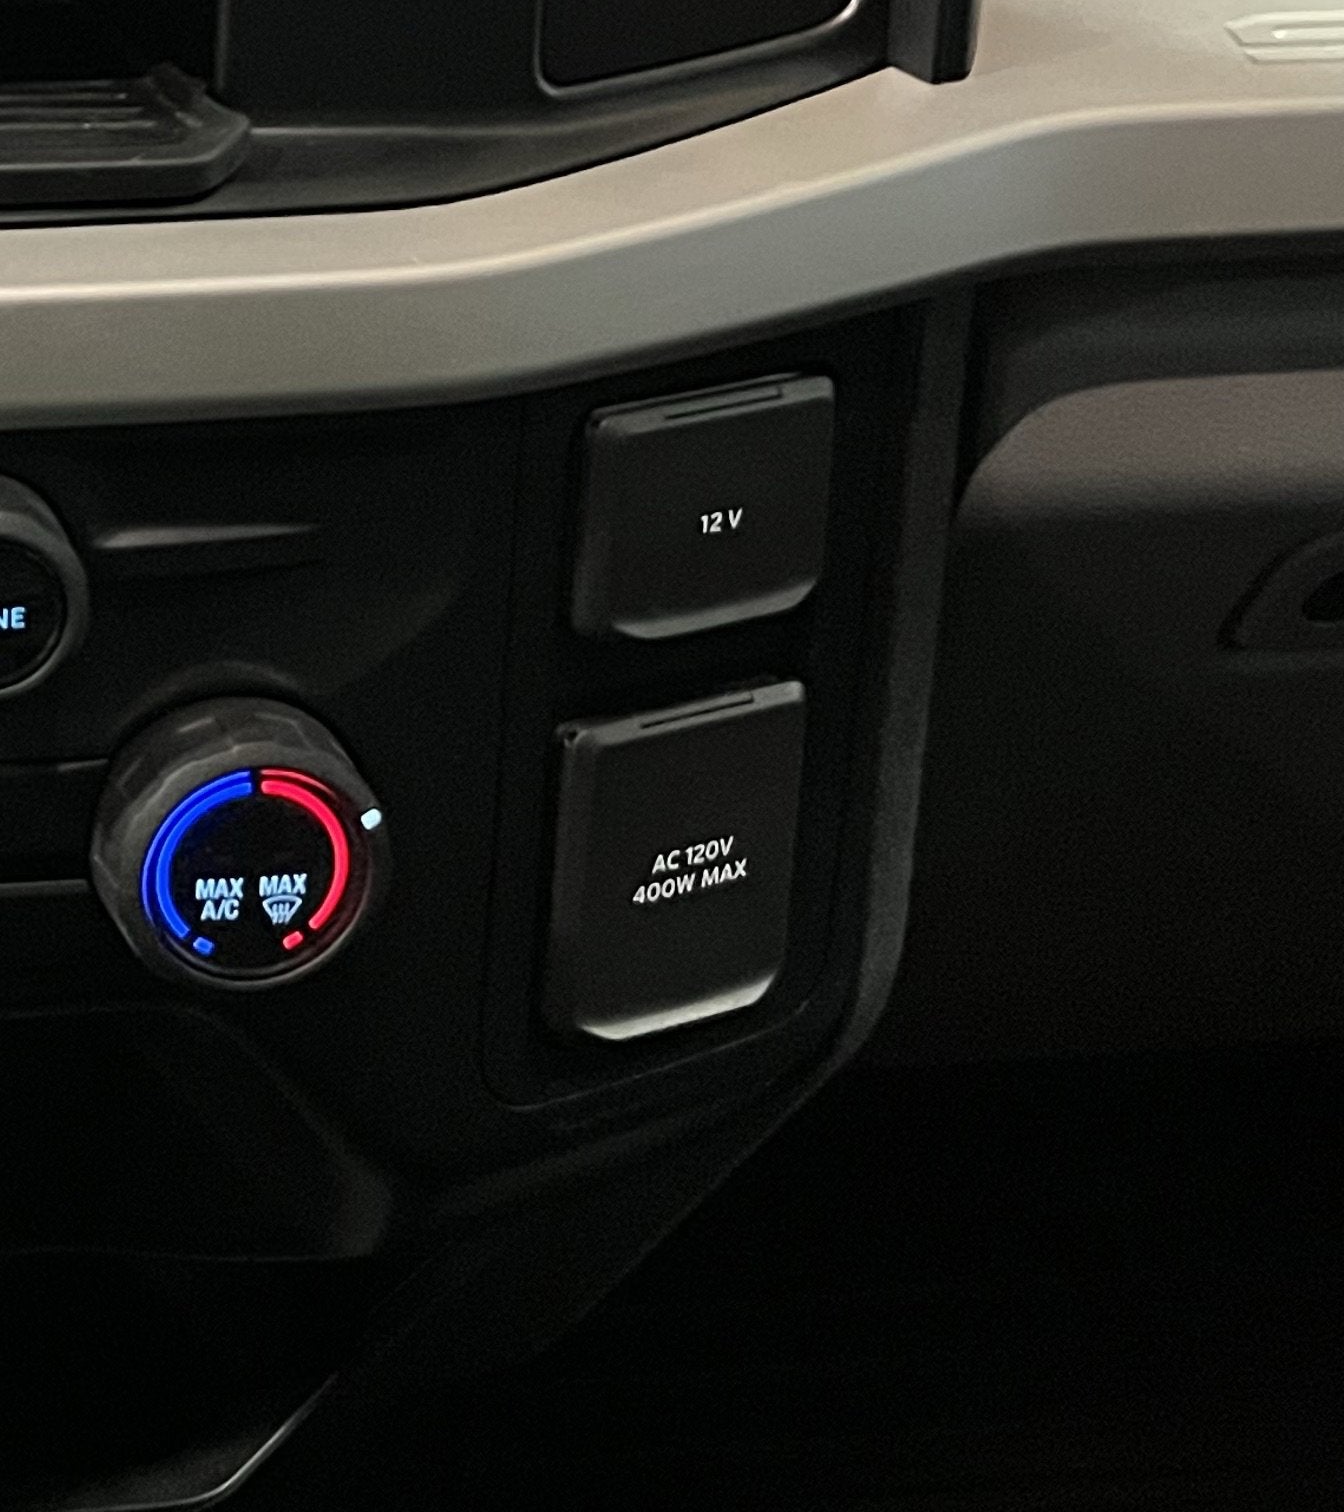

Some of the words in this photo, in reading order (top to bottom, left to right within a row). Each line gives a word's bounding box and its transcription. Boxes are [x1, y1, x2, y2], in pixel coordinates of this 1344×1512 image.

[700, 509, 723, 534] 12
[729, 508, 743, 529] V
[652, 849, 680, 875] AC
[685, 835, 734, 865] 120V
[195, 877, 244, 899] MAX
[258, 872, 308, 896] MAX
[632, 871, 696, 904] 400W
[701, 858, 747, 889] MAX
[200, 899, 240, 921] A/C
